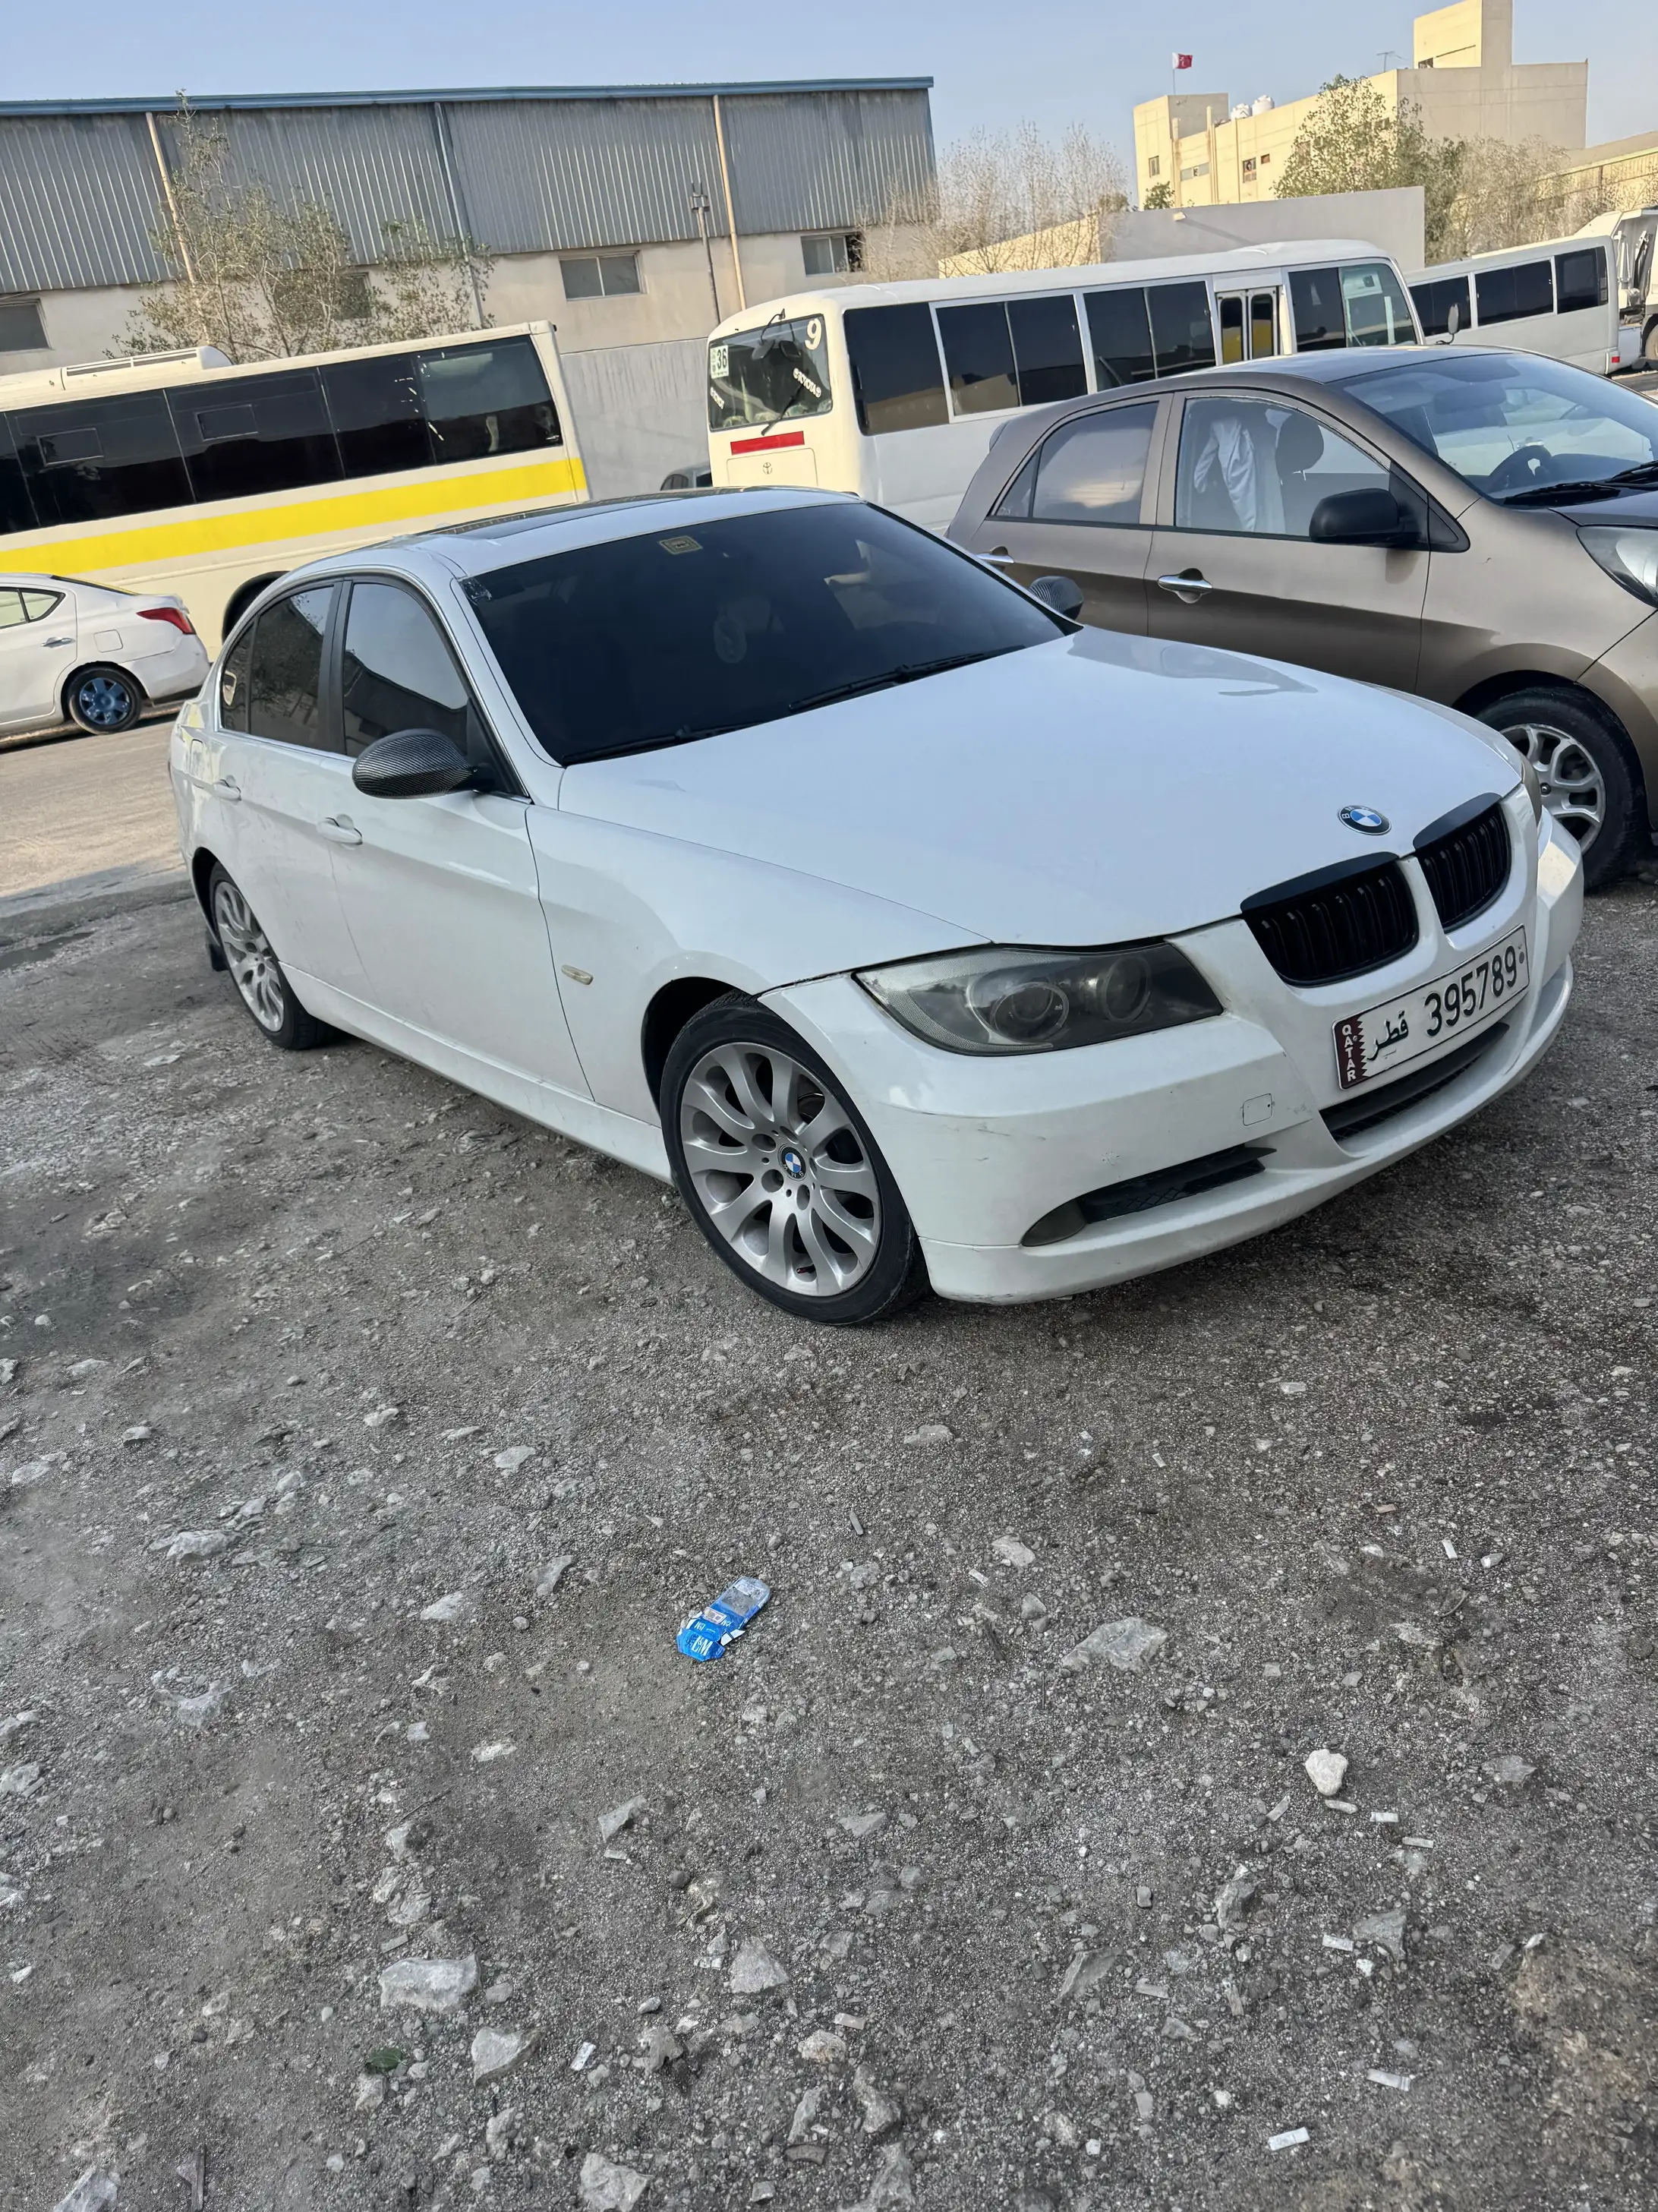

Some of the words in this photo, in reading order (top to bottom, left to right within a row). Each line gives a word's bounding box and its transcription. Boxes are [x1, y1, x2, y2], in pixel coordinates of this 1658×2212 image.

[805, 318, 822, 350] 9
[717, 348, 727, 369] 36
[1423, 945, 1518, 1038] 395789
[1341, 1024, 1357, 1083] QATAR
[1366, 1010, 1410, 1062] قطر
[691, 1636, 714, 1656] L&M
